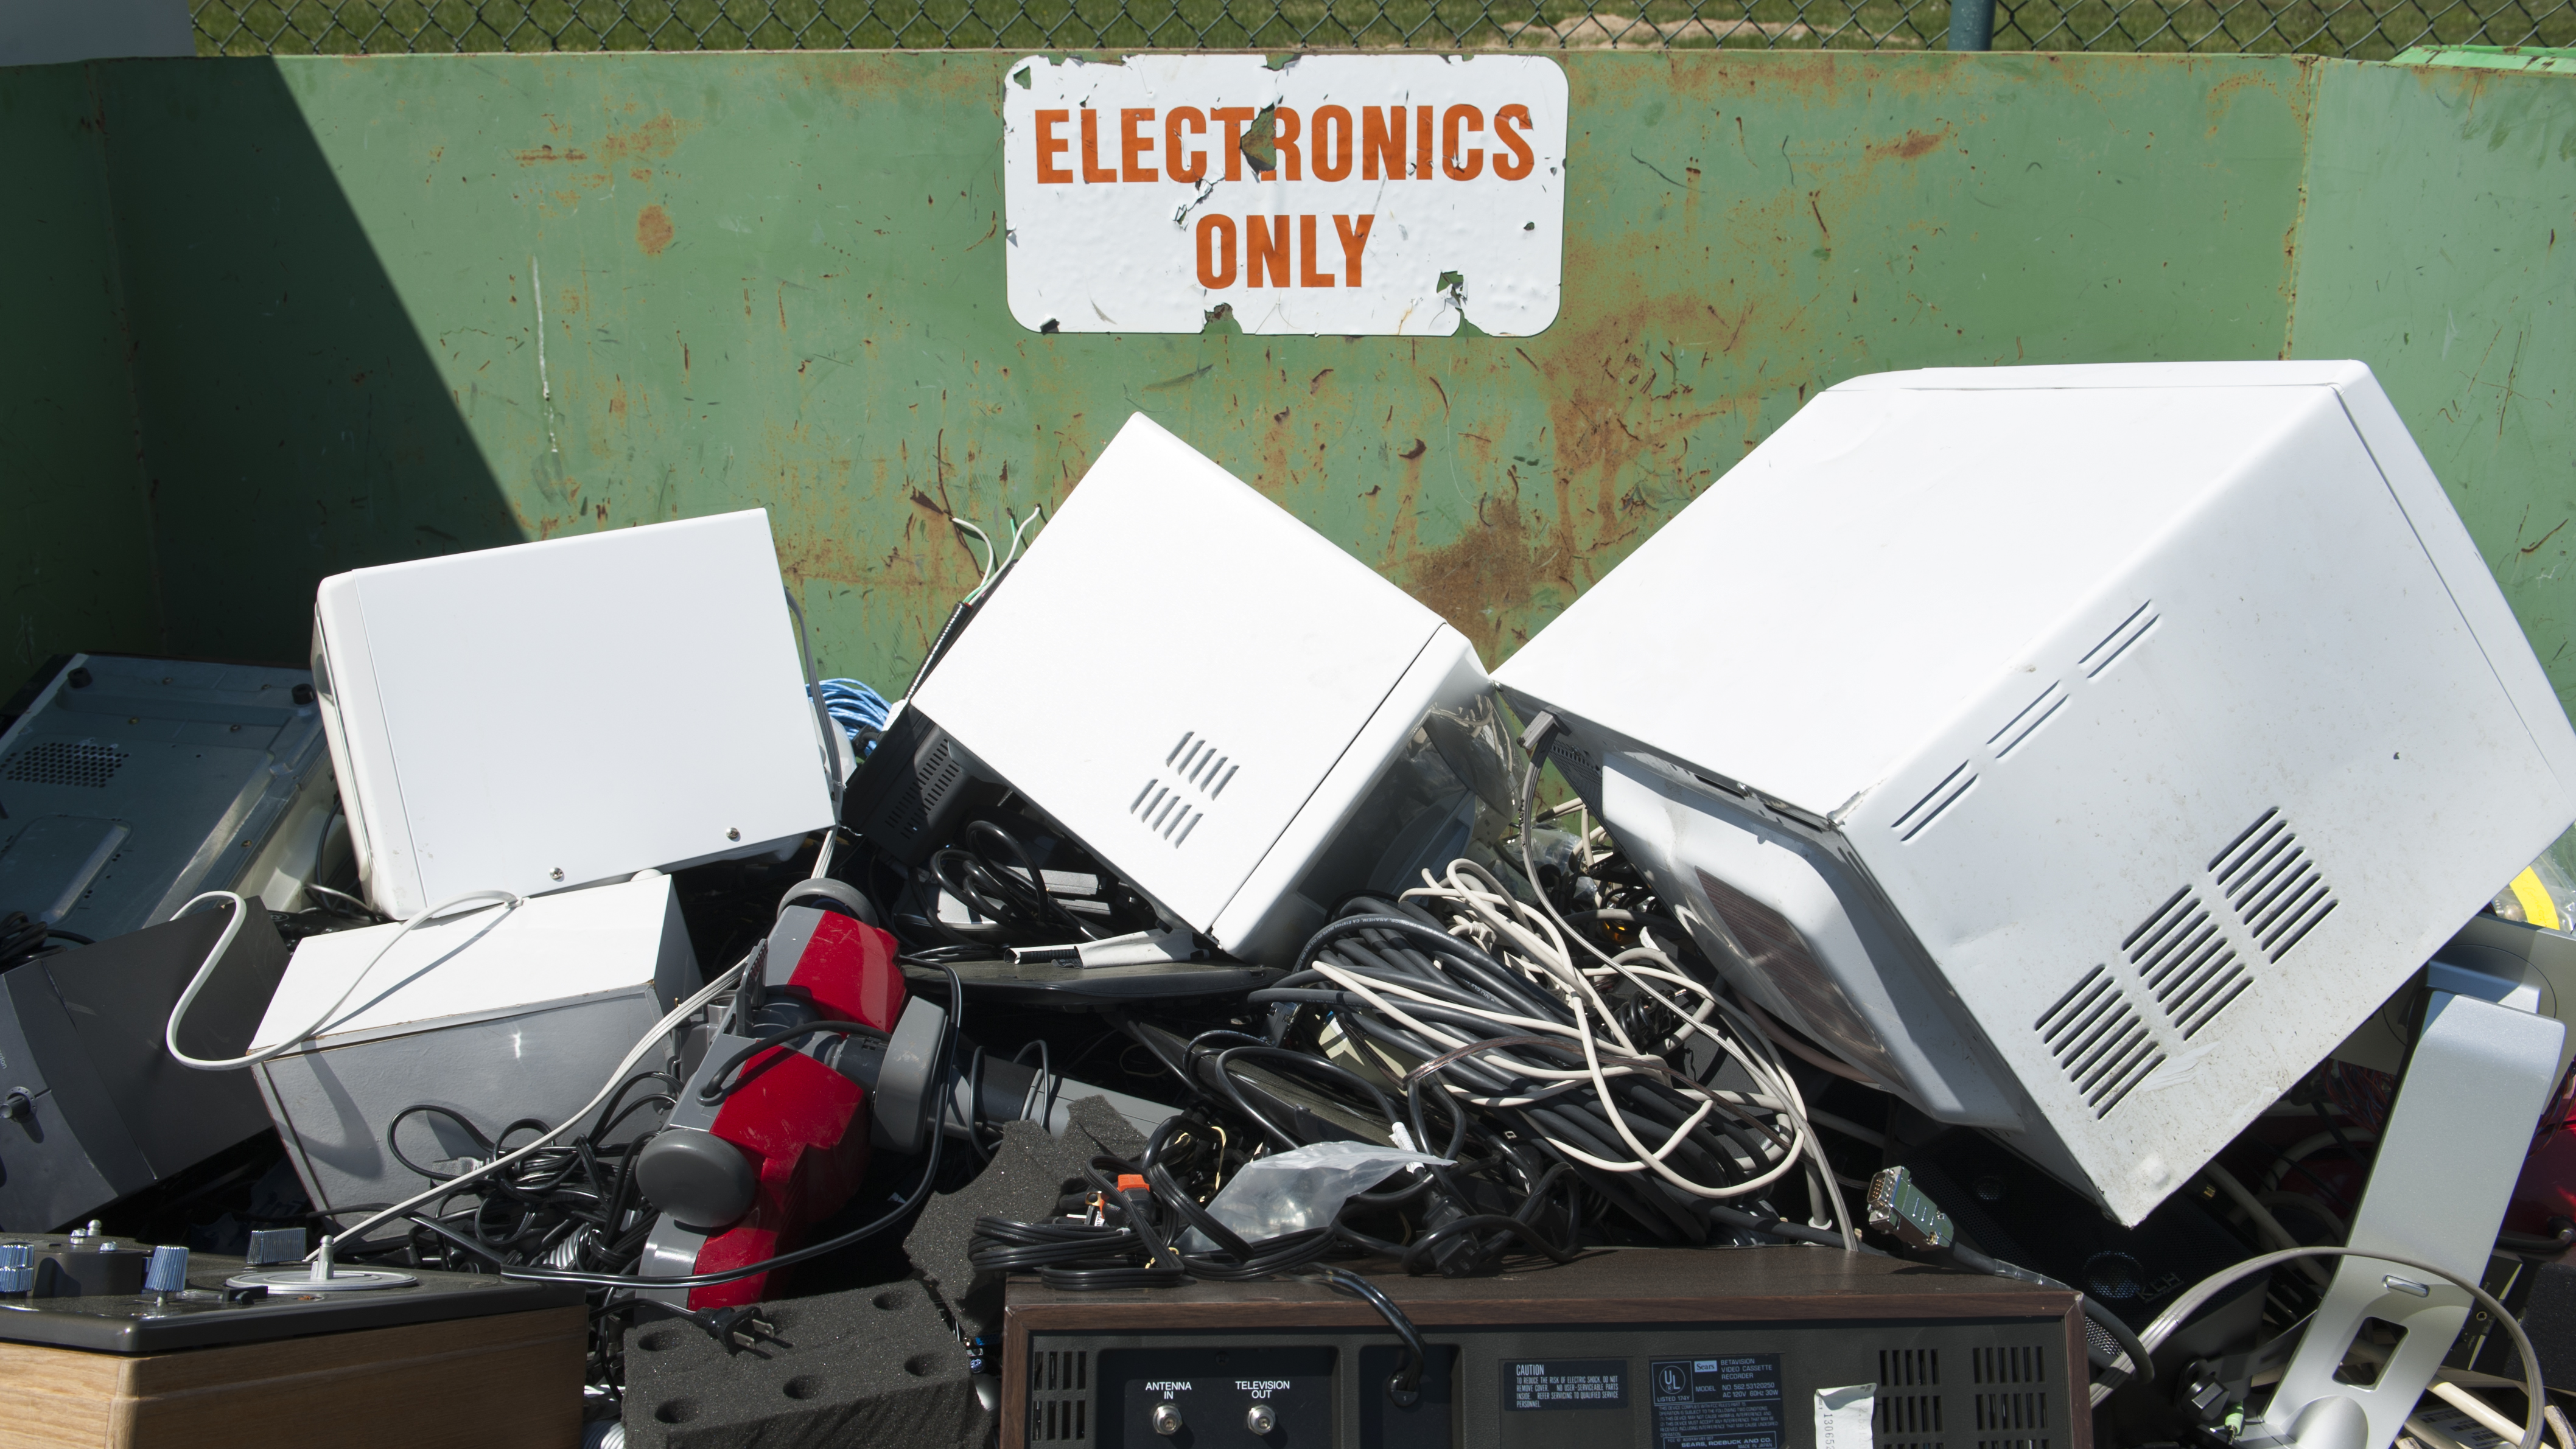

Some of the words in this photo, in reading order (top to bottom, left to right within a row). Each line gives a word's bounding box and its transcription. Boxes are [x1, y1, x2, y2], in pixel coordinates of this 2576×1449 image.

[1035, 103, 1534, 184] ELECTRONICS
[1195, 213, 1374, 290] ONLY
[2135, 1273, 2181, 1300] KLH
[1516, 1364, 1544, 1376] CAUTION
[1145, 1381, 1192, 1391] ANTENNA
[1235, 1381, 1290, 1390] TELEVISION
[1665, 1370, 1680, 1389] UL
[1251, 1390, 1272, 1398] OUT
